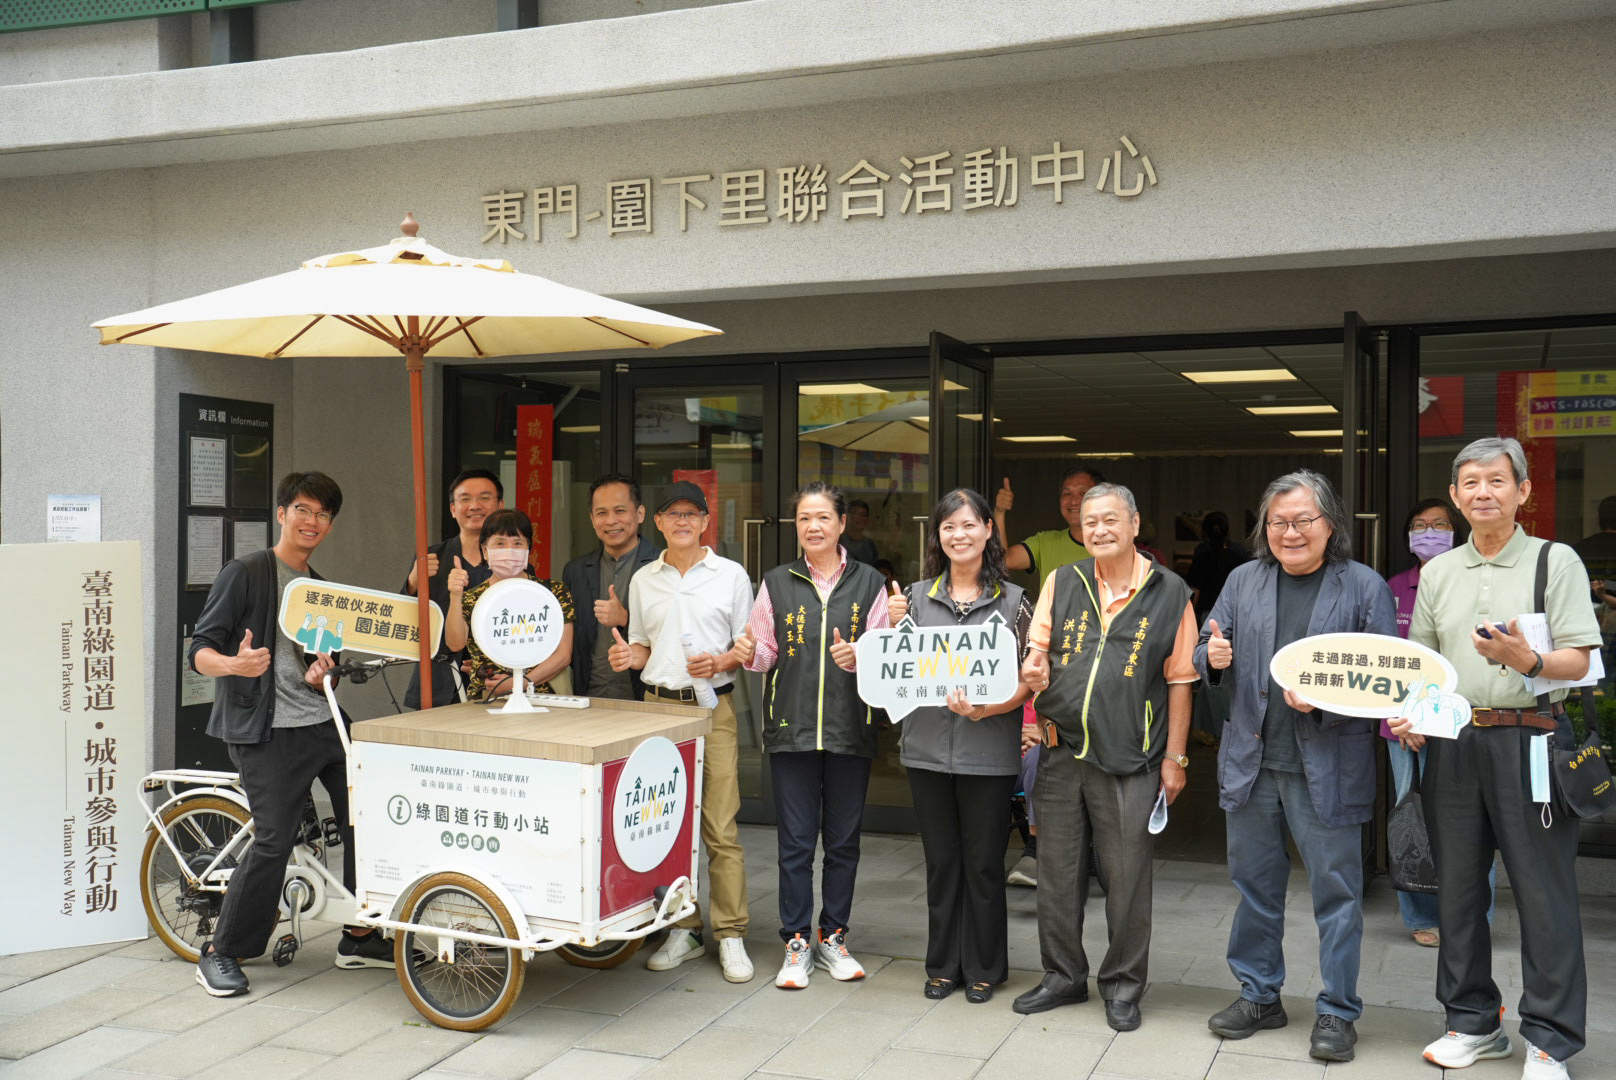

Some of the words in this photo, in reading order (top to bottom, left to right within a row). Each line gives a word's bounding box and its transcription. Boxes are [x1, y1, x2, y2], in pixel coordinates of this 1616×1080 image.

[198, 408, 227, 423] 資訊欄
[230, 416, 269, 428] Information
[305, 590, 394, 618] 逐家做伙來做
[492, 608, 549, 625] TAINAN
[61, 620, 73, 659] Tainan
[785, 612, 796, 657] 黃玉女
[796, 605, 806, 644] 大德里長
[879, 626, 998, 653] TAINAN
[1123, 617, 1149, 677] 臺南市東區
[59, 663, 74, 713] Parkway
[411, 763, 434, 774] TAINAN
[436, 766, 464, 777] PARKYAY
[472, 770, 496, 780] TAINAN
[497, 773, 513, 783] NEW
[515, 775, 530, 784] WAY
[625, 776, 678, 807] TAINAN
[416, 802, 549, 835] 綠園道行動小站
[63, 816, 75, 857] Tainan
[64, 860, 76, 886] New
[60, 889, 76, 917] Way
